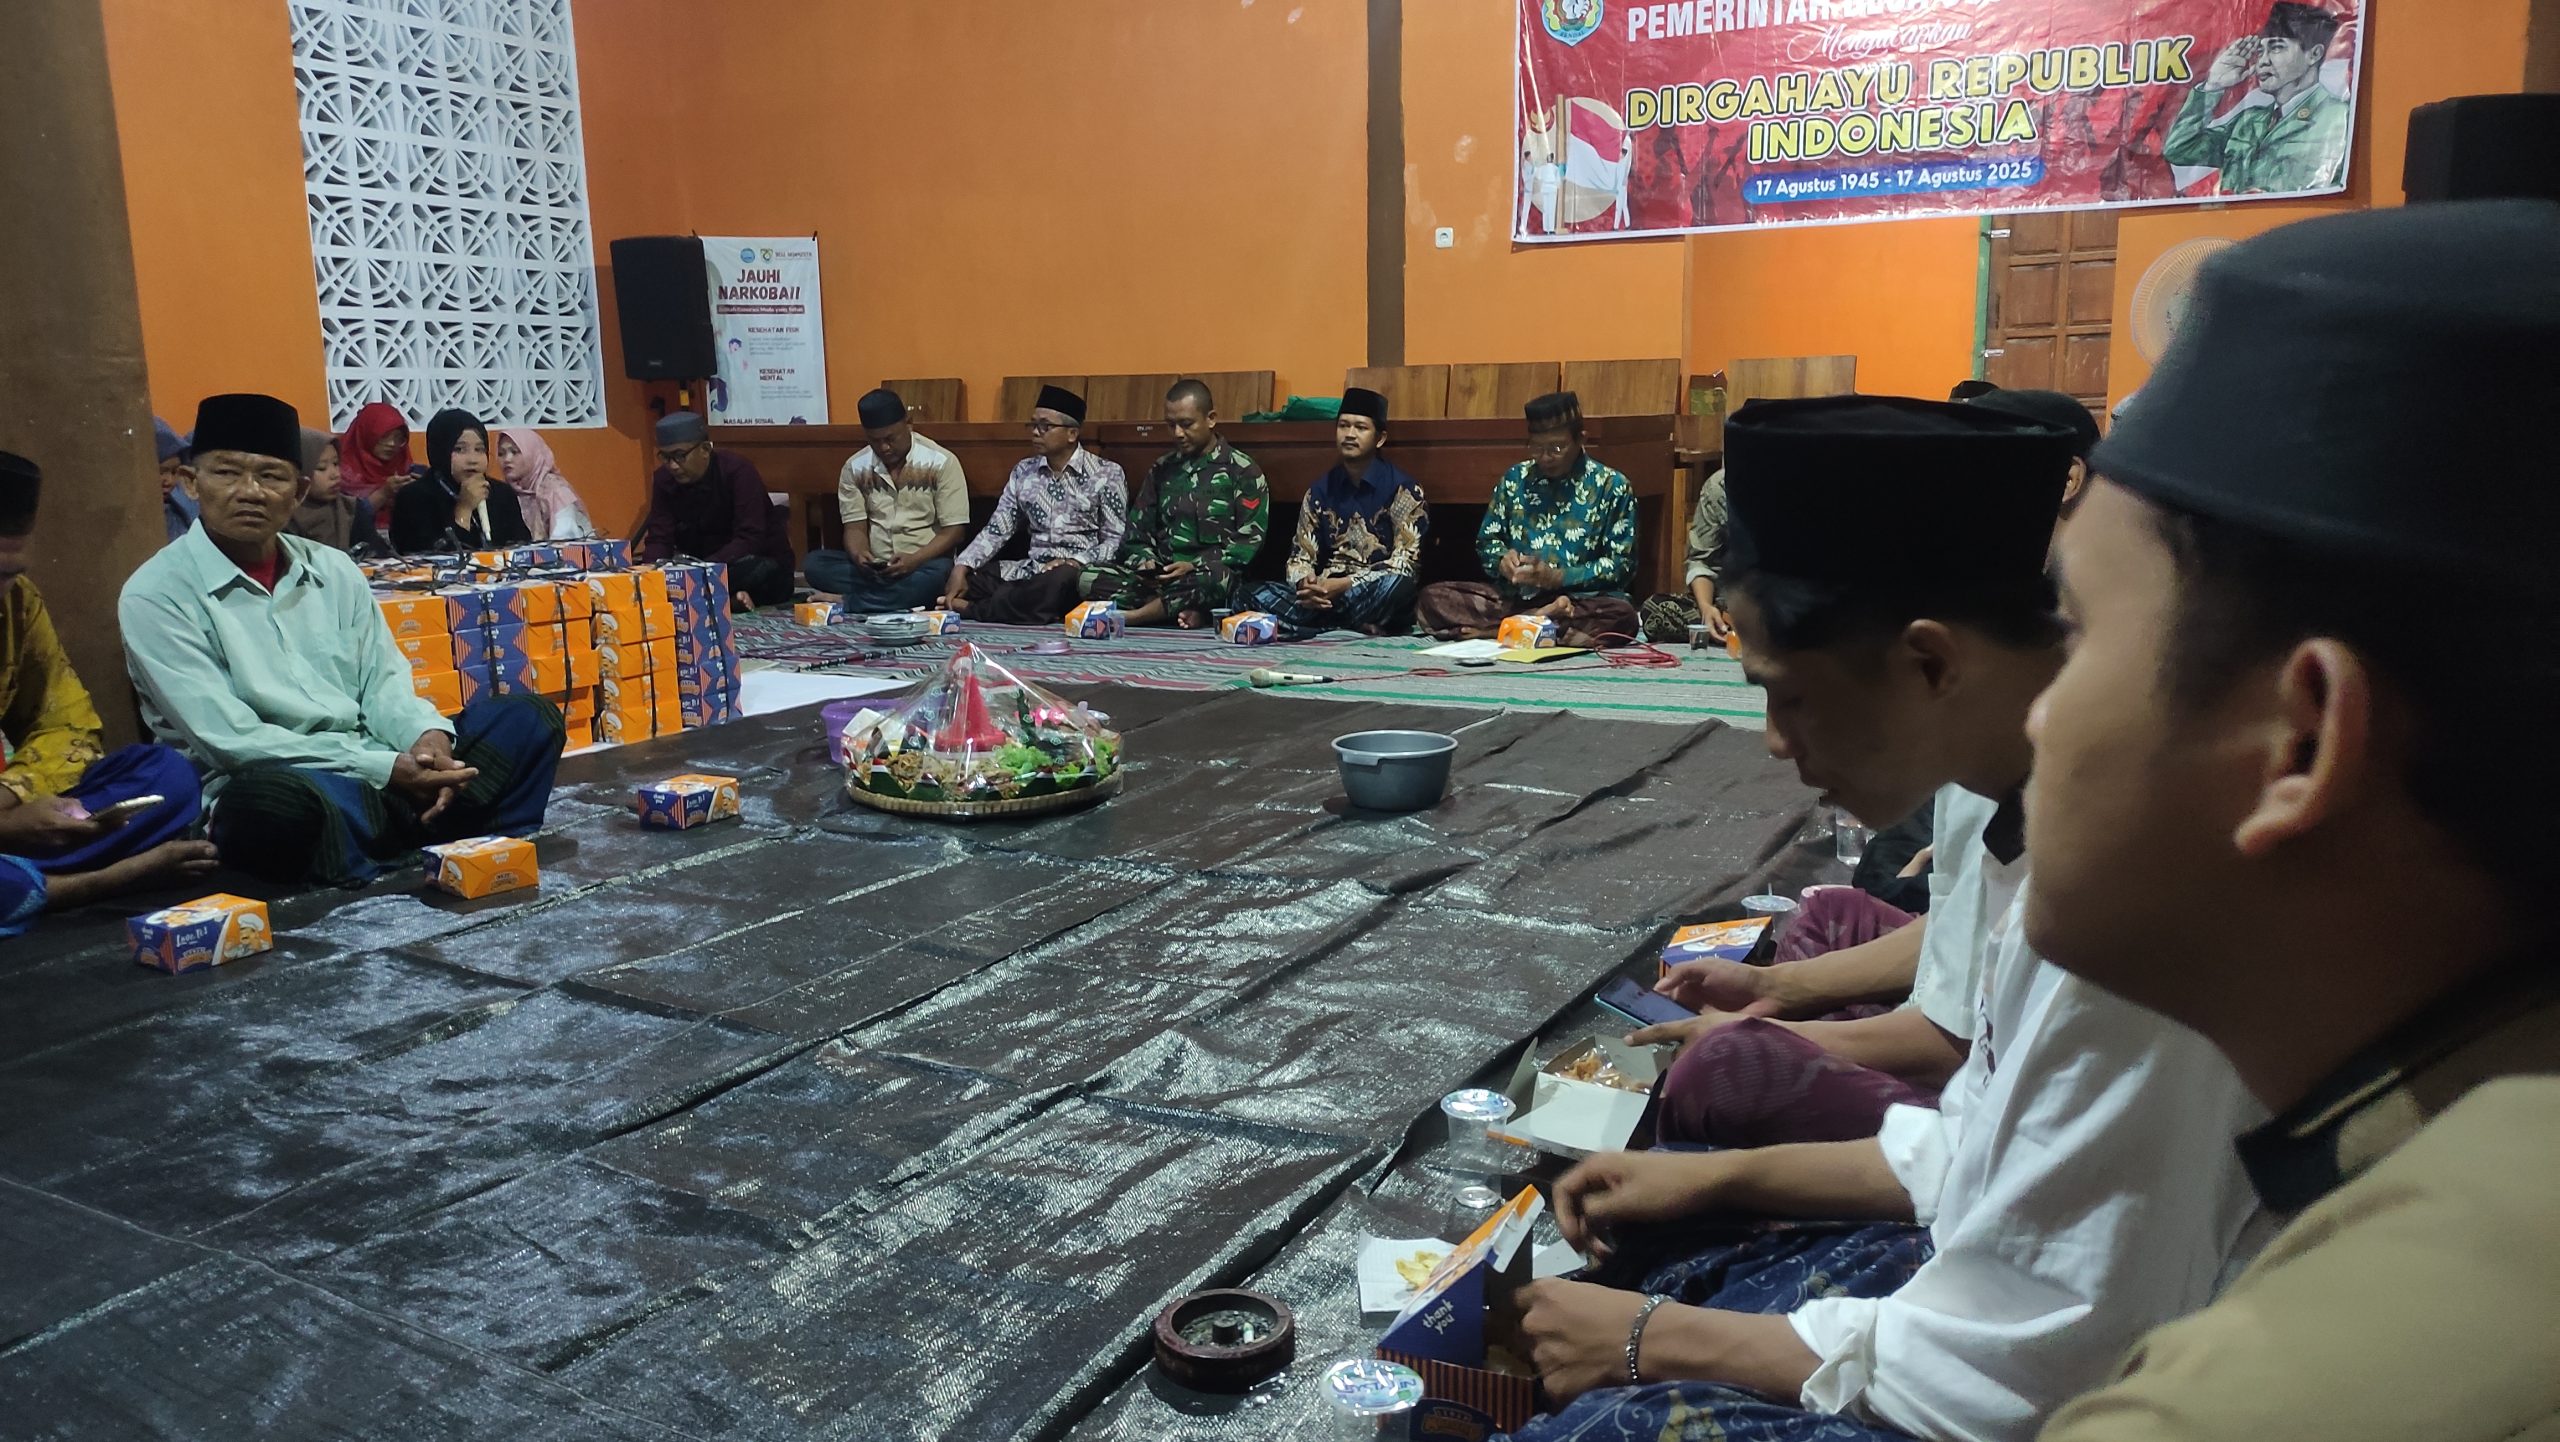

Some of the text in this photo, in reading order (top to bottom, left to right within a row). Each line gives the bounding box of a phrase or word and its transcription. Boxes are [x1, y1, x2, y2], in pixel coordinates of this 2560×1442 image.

[1627, 36, 2194, 128] DIRGAHAYU REPUBLIK
[1748, 100, 2037, 162] INDONESIA
[1756, 179, 1772, 196] 17
[1775, 178, 1836, 198] Agustus
[1840, 172, 1879, 190] 1945
[1897, 169, 1914, 187] 17
[1917, 167, 1982, 188] Agustus
[1987, 161, 2032, 180] 2025
[737, 269, 780, 283] JAUHI
[1422, 1299, 1454, 1328] thank
[1434, 1314, 1456, 1335] you
